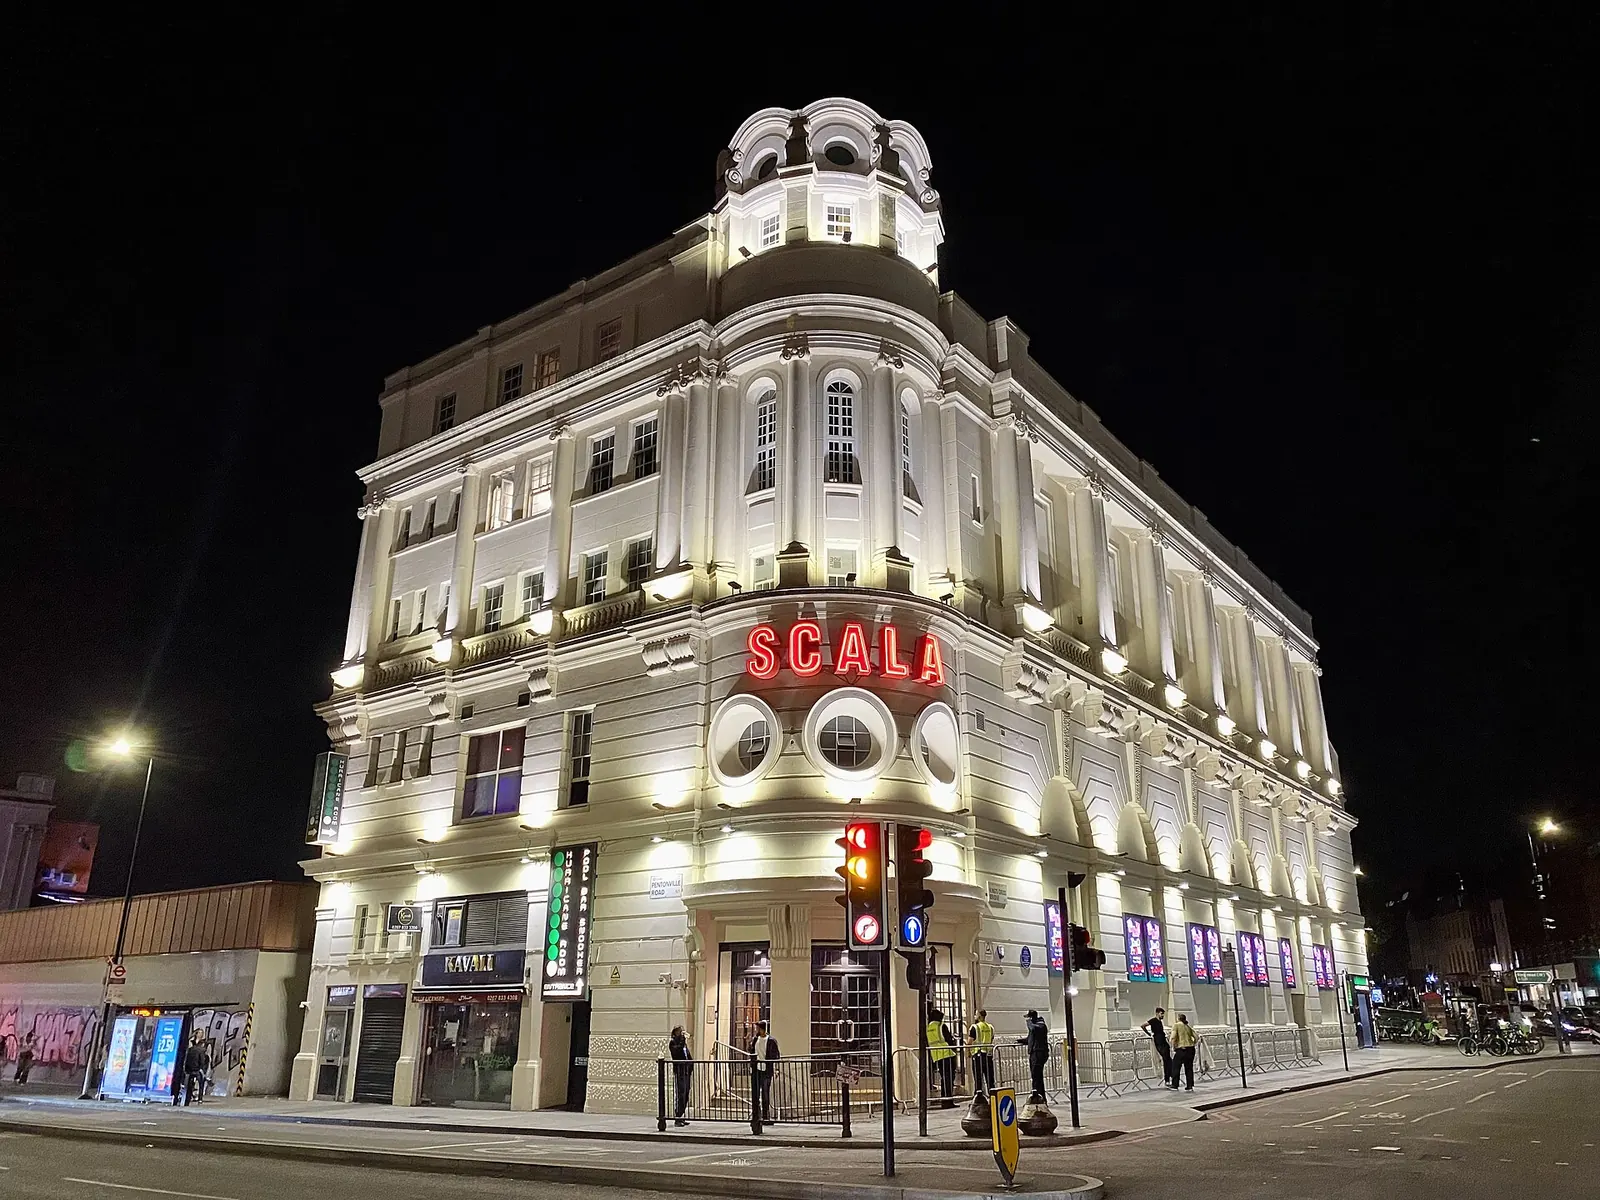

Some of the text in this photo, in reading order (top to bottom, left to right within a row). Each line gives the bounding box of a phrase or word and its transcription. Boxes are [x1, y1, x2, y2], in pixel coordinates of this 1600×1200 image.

[747, 621, 946, 686] SCALA
[331, 806, 339, 826] ROOM
[557, 851, 573, 977] HURRICANE ROOM
[575, 848, 591, 976] POOL BAR SNOOKER
[651, 880, 681, 888] PENTONVILLE
